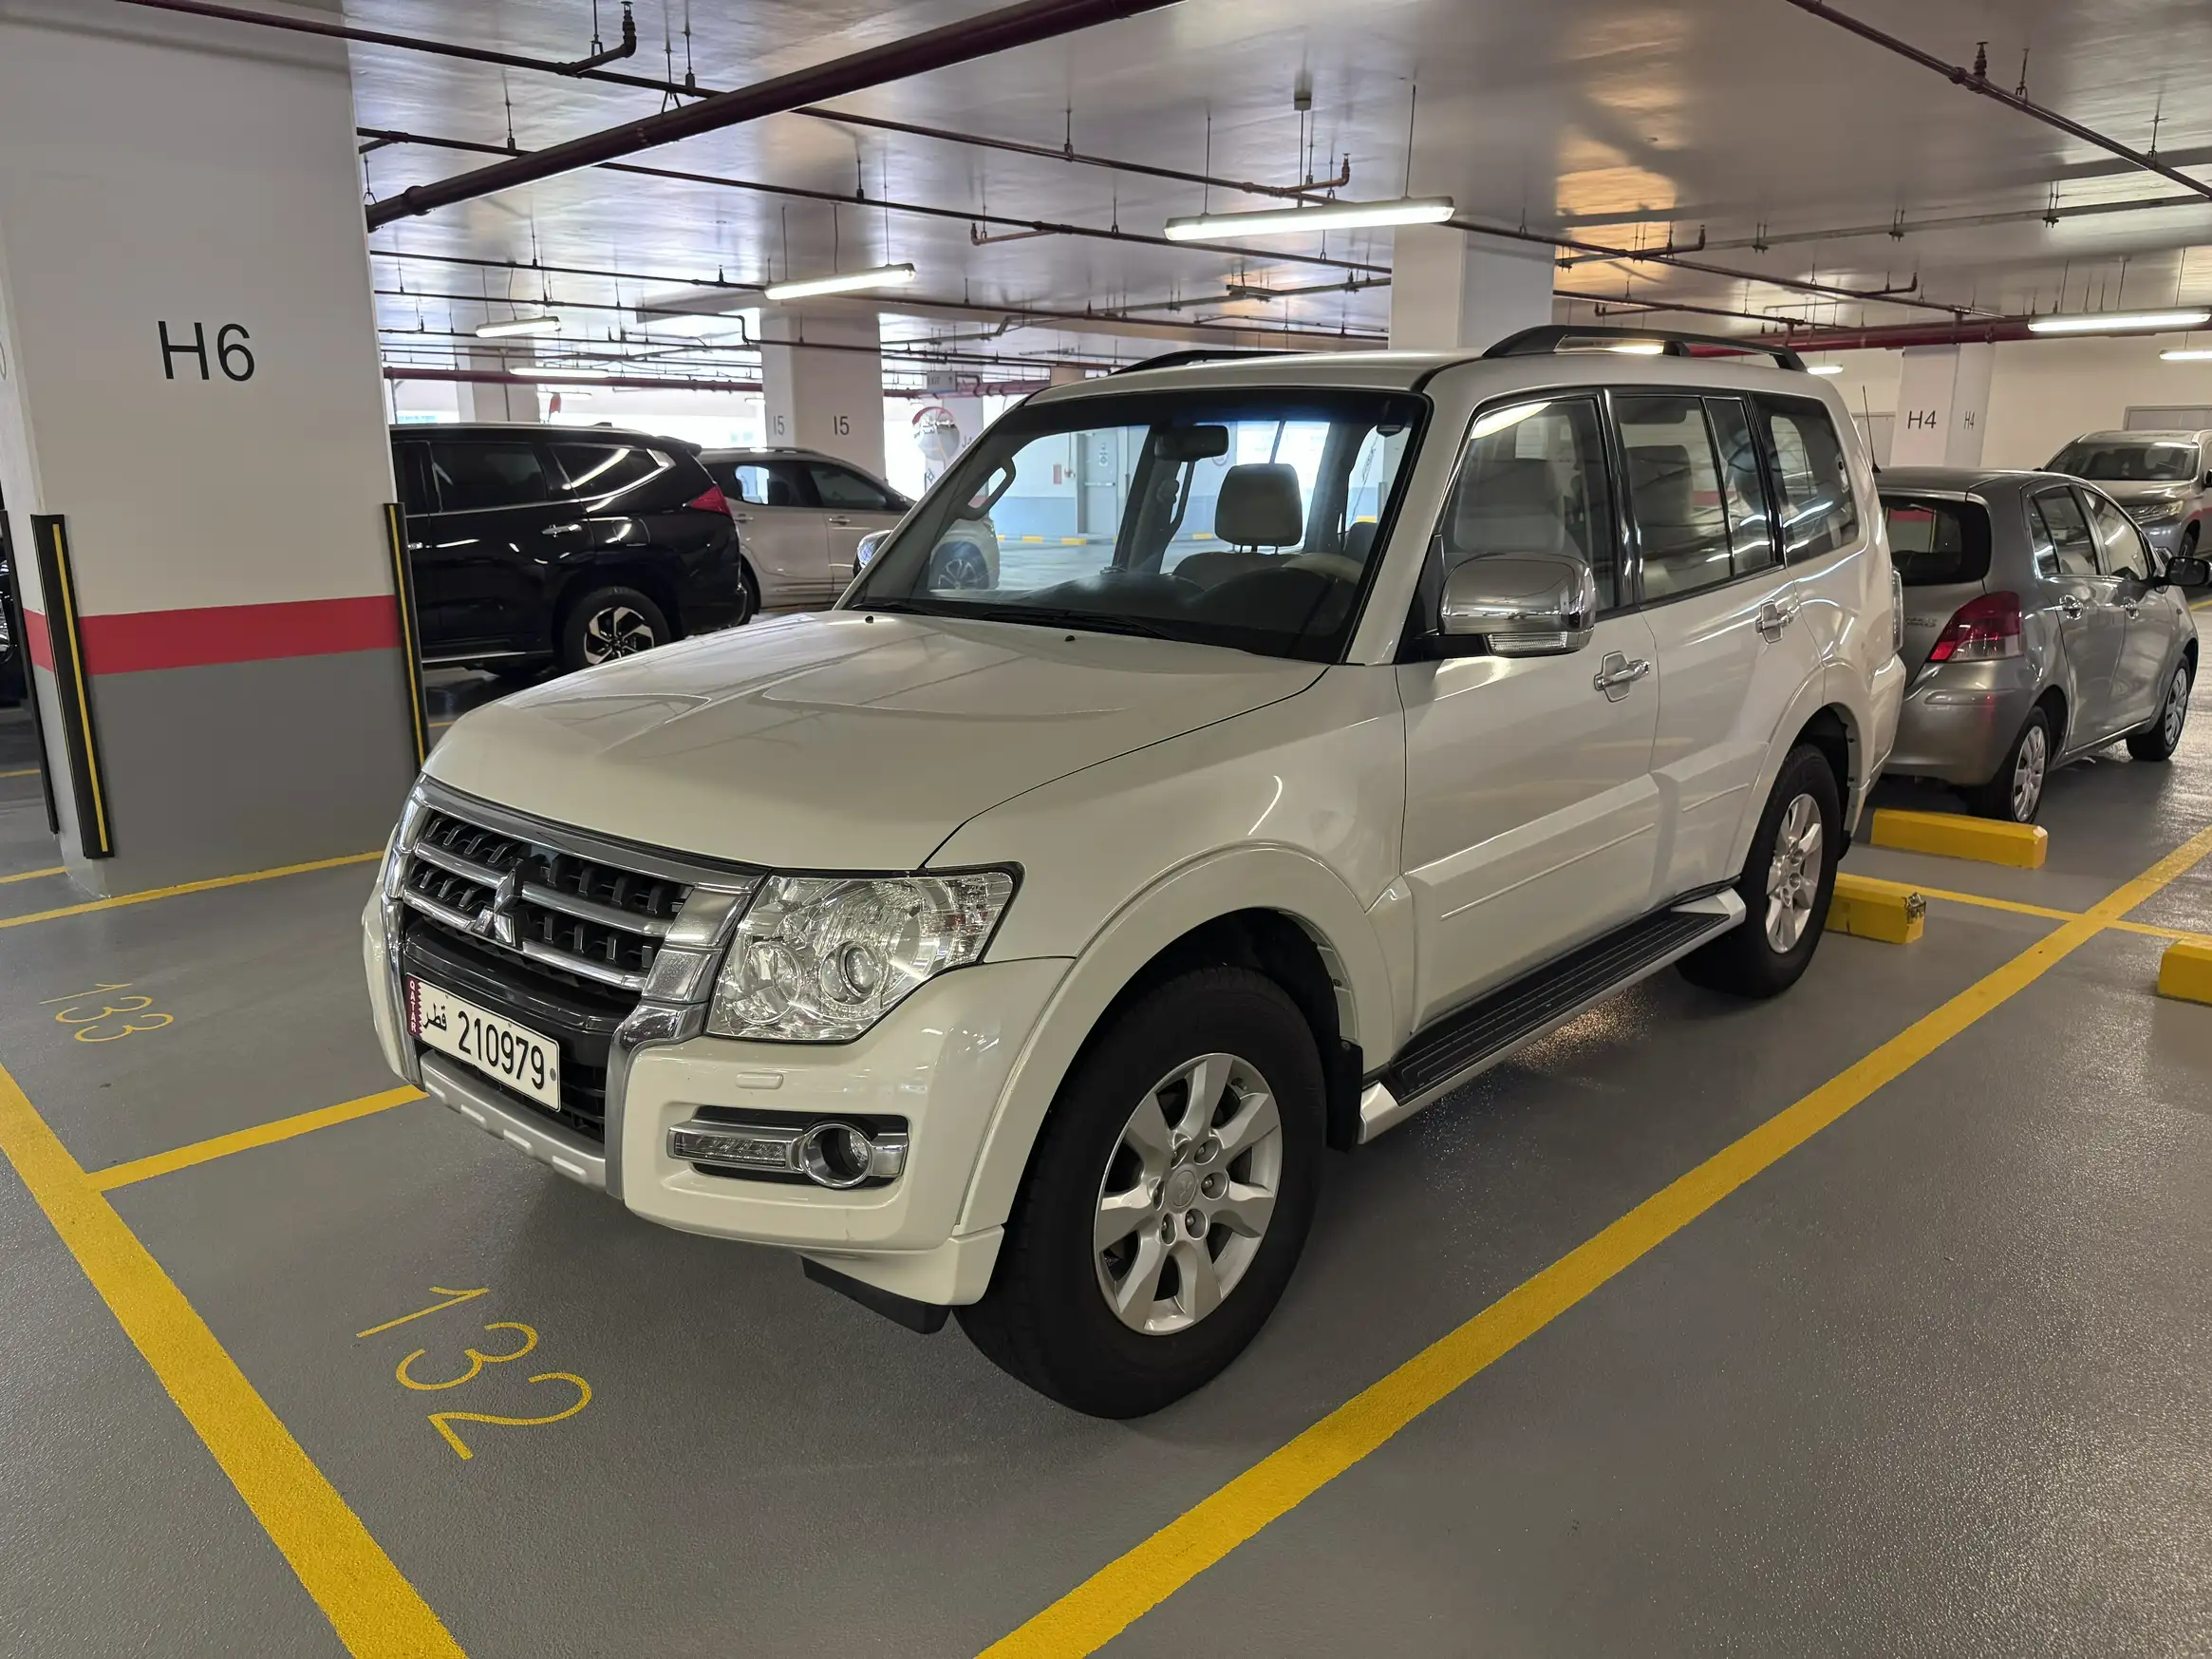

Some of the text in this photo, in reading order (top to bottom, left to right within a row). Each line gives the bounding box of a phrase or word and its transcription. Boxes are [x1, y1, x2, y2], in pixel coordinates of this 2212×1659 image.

[157, 320, 255, 382] H6
[1906, 409, 1937, 430] H4
[39, 982, 175, 1044] 133
[422, 1002, 545, 1091] قطر 210979
[355, 1286, 593, 1461] 132
